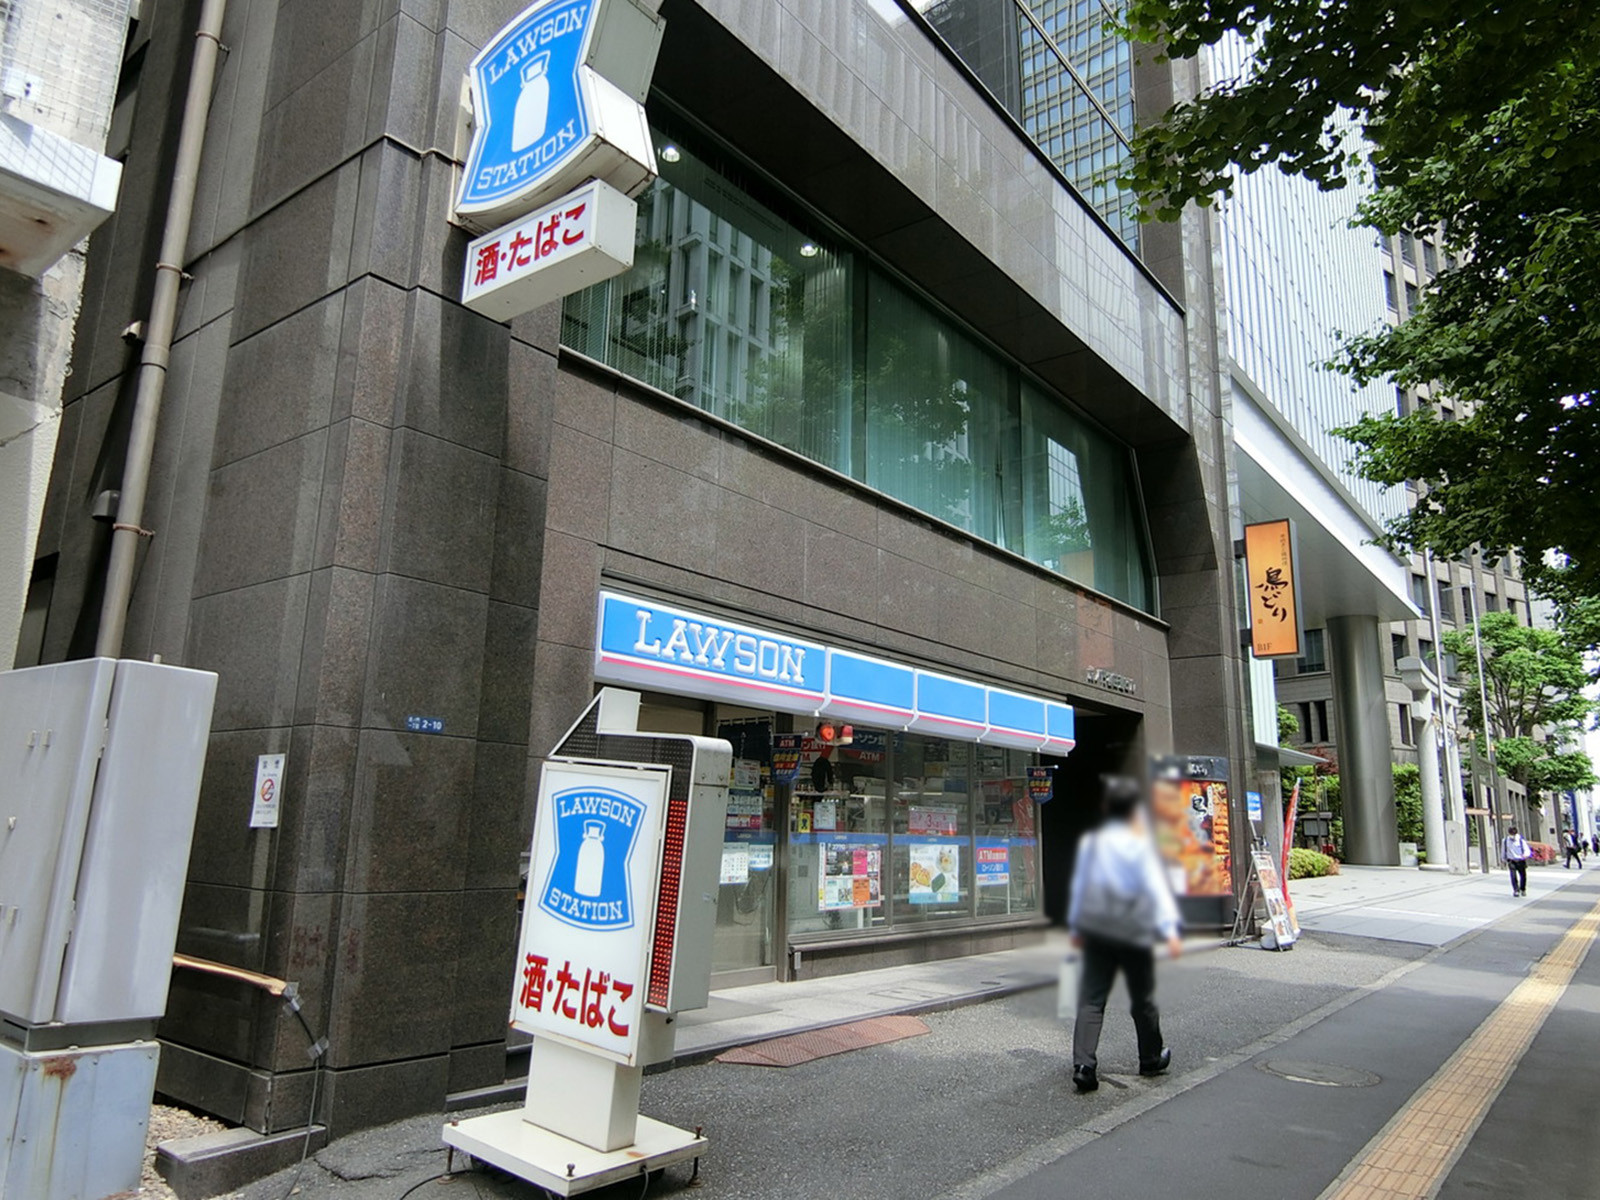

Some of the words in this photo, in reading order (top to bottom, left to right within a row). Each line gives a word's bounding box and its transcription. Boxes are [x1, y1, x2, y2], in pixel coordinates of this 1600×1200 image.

[488, 6, 587, 85] LAWSON
[476, 119, 576, 191] STATION
[474, 202, 587, 286] 酒・たばこ
[634, 610, 805, 685] LAWSON
[1257, 643, 1272, 652] B1F
[421, 719, 443, 730] 2-10
[780, 739, 796, 748] ATM
[859, 751, 880, 762] ATM
[560, 796, 636, 828] LAWSON
[549, 886, 624, 921] STATION
[520, 951, 634, 1038] 酒・たばこ
